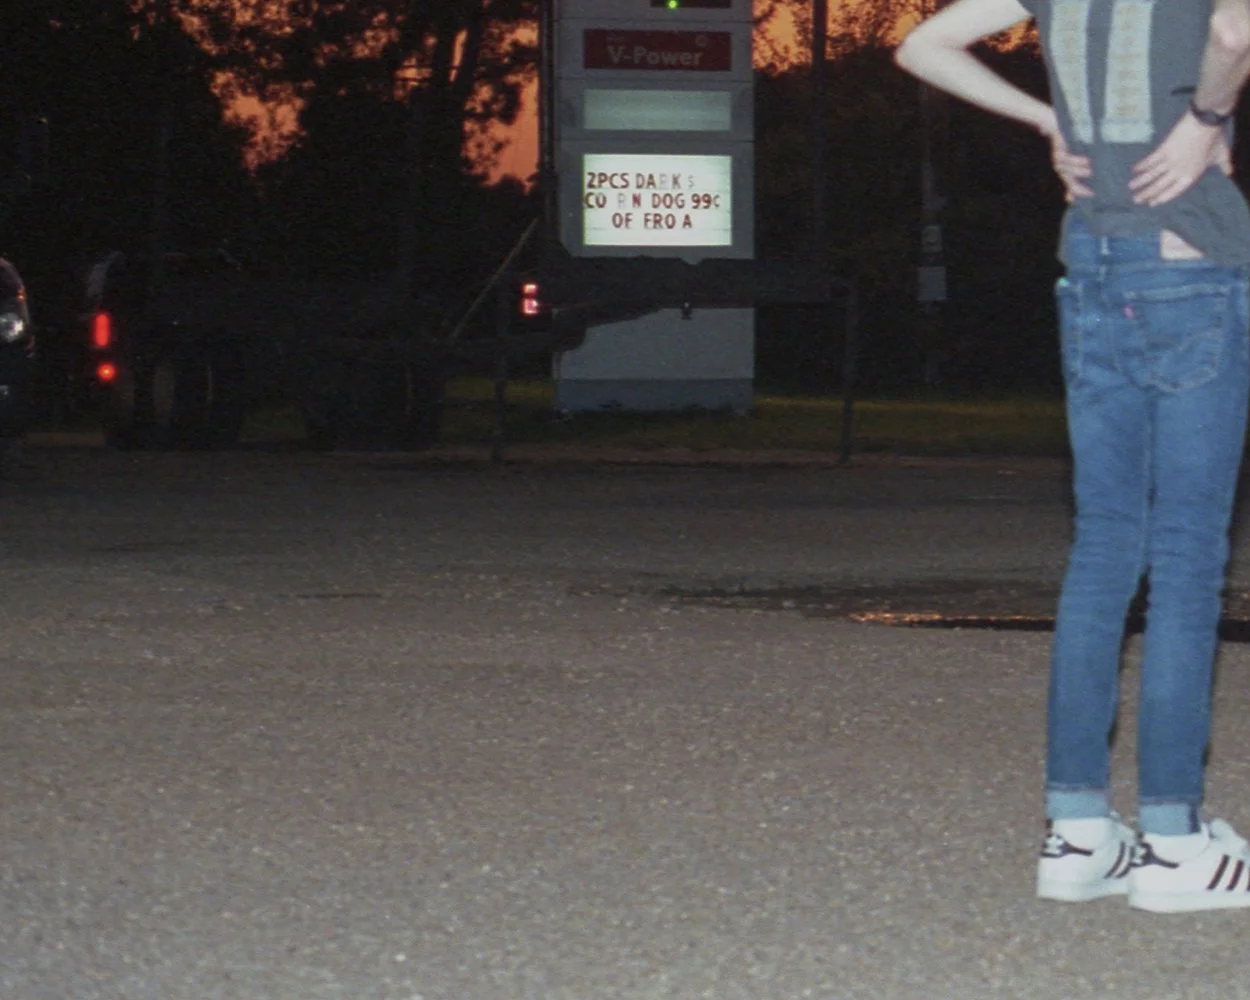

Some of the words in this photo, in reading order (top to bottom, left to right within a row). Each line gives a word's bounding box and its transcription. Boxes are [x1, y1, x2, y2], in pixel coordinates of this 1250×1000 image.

[606, 44, 703, 66] V-Power
[587, 172, 629, 189] 2PCS
[652, 192, 685, 209] DOG
[611, 212, 633, 229] OF
